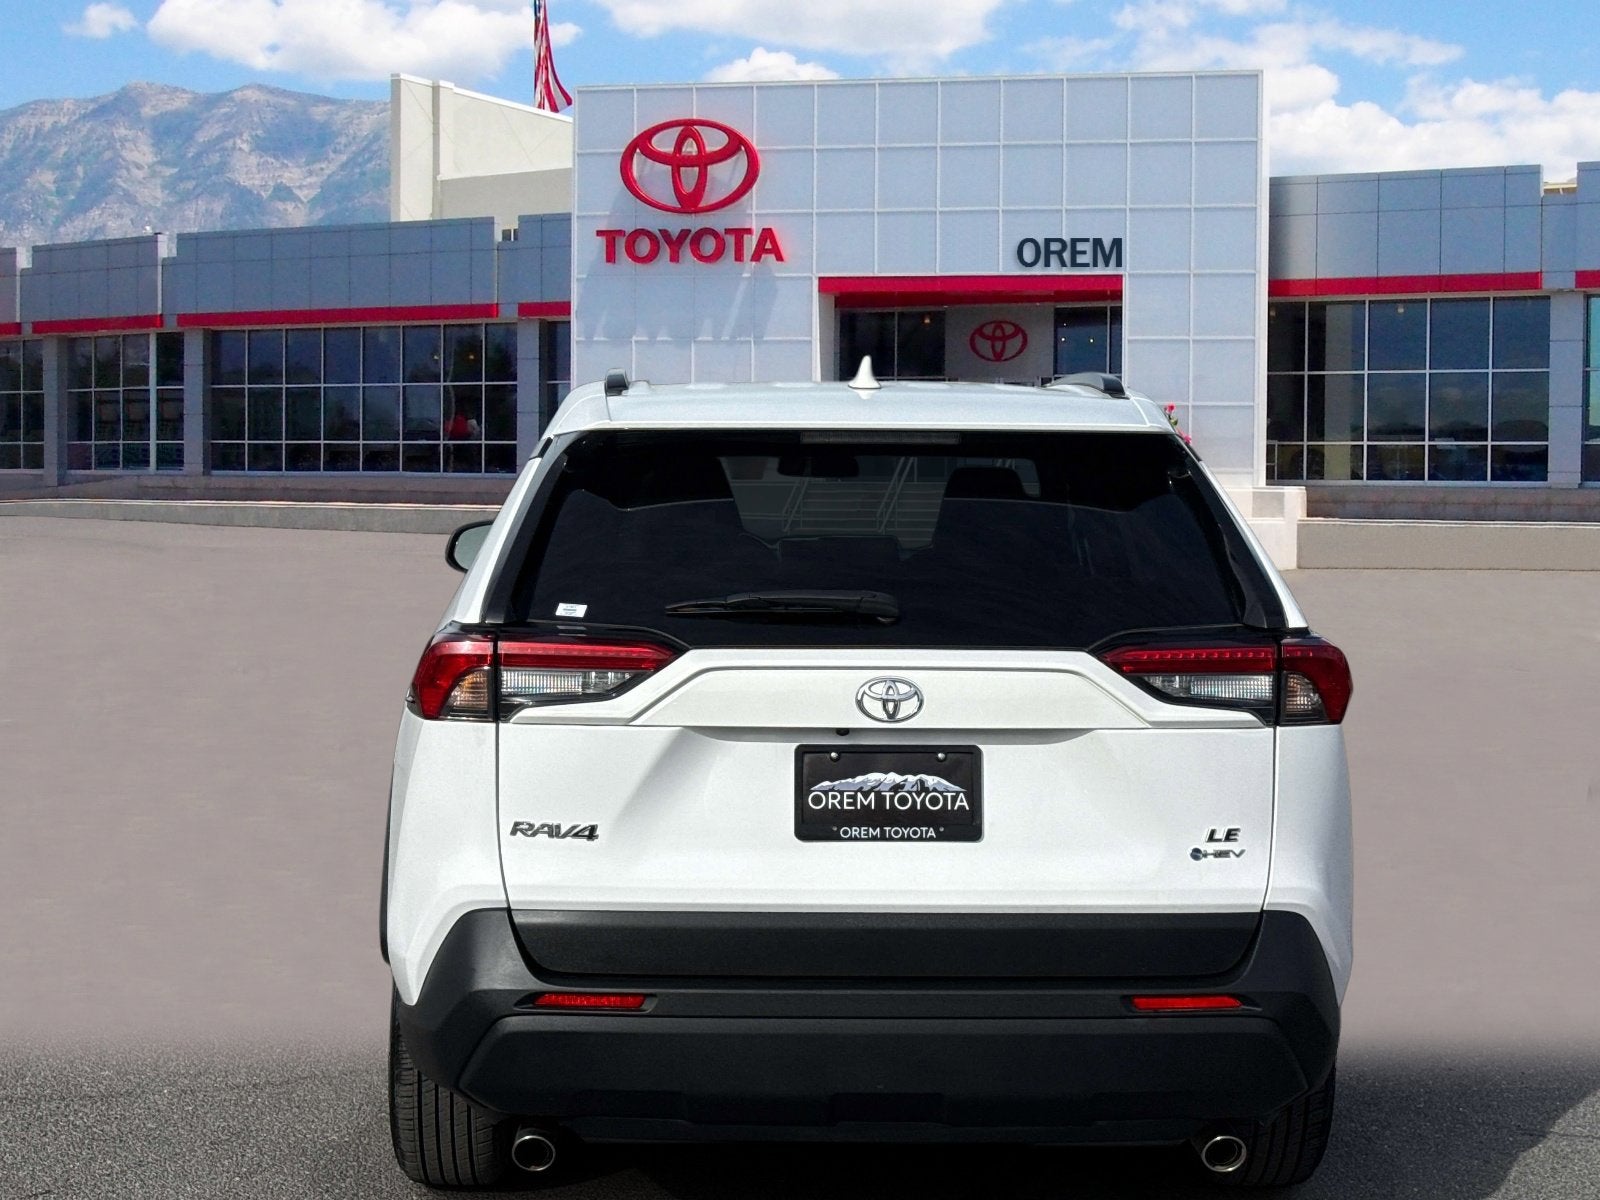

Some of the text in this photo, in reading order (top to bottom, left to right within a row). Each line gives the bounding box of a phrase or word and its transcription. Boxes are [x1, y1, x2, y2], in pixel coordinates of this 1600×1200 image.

[596, 227, 786, 264] TOYOTA
[1016, 237, 1123, 268] OREM
[808, 791, 970, 811] OREM TOYOTA
[510, 821, 599, 842] RAV4
[839, 826, 937, 839] OREM TOYOTA
[1206, 827, 1241, 843] LE
